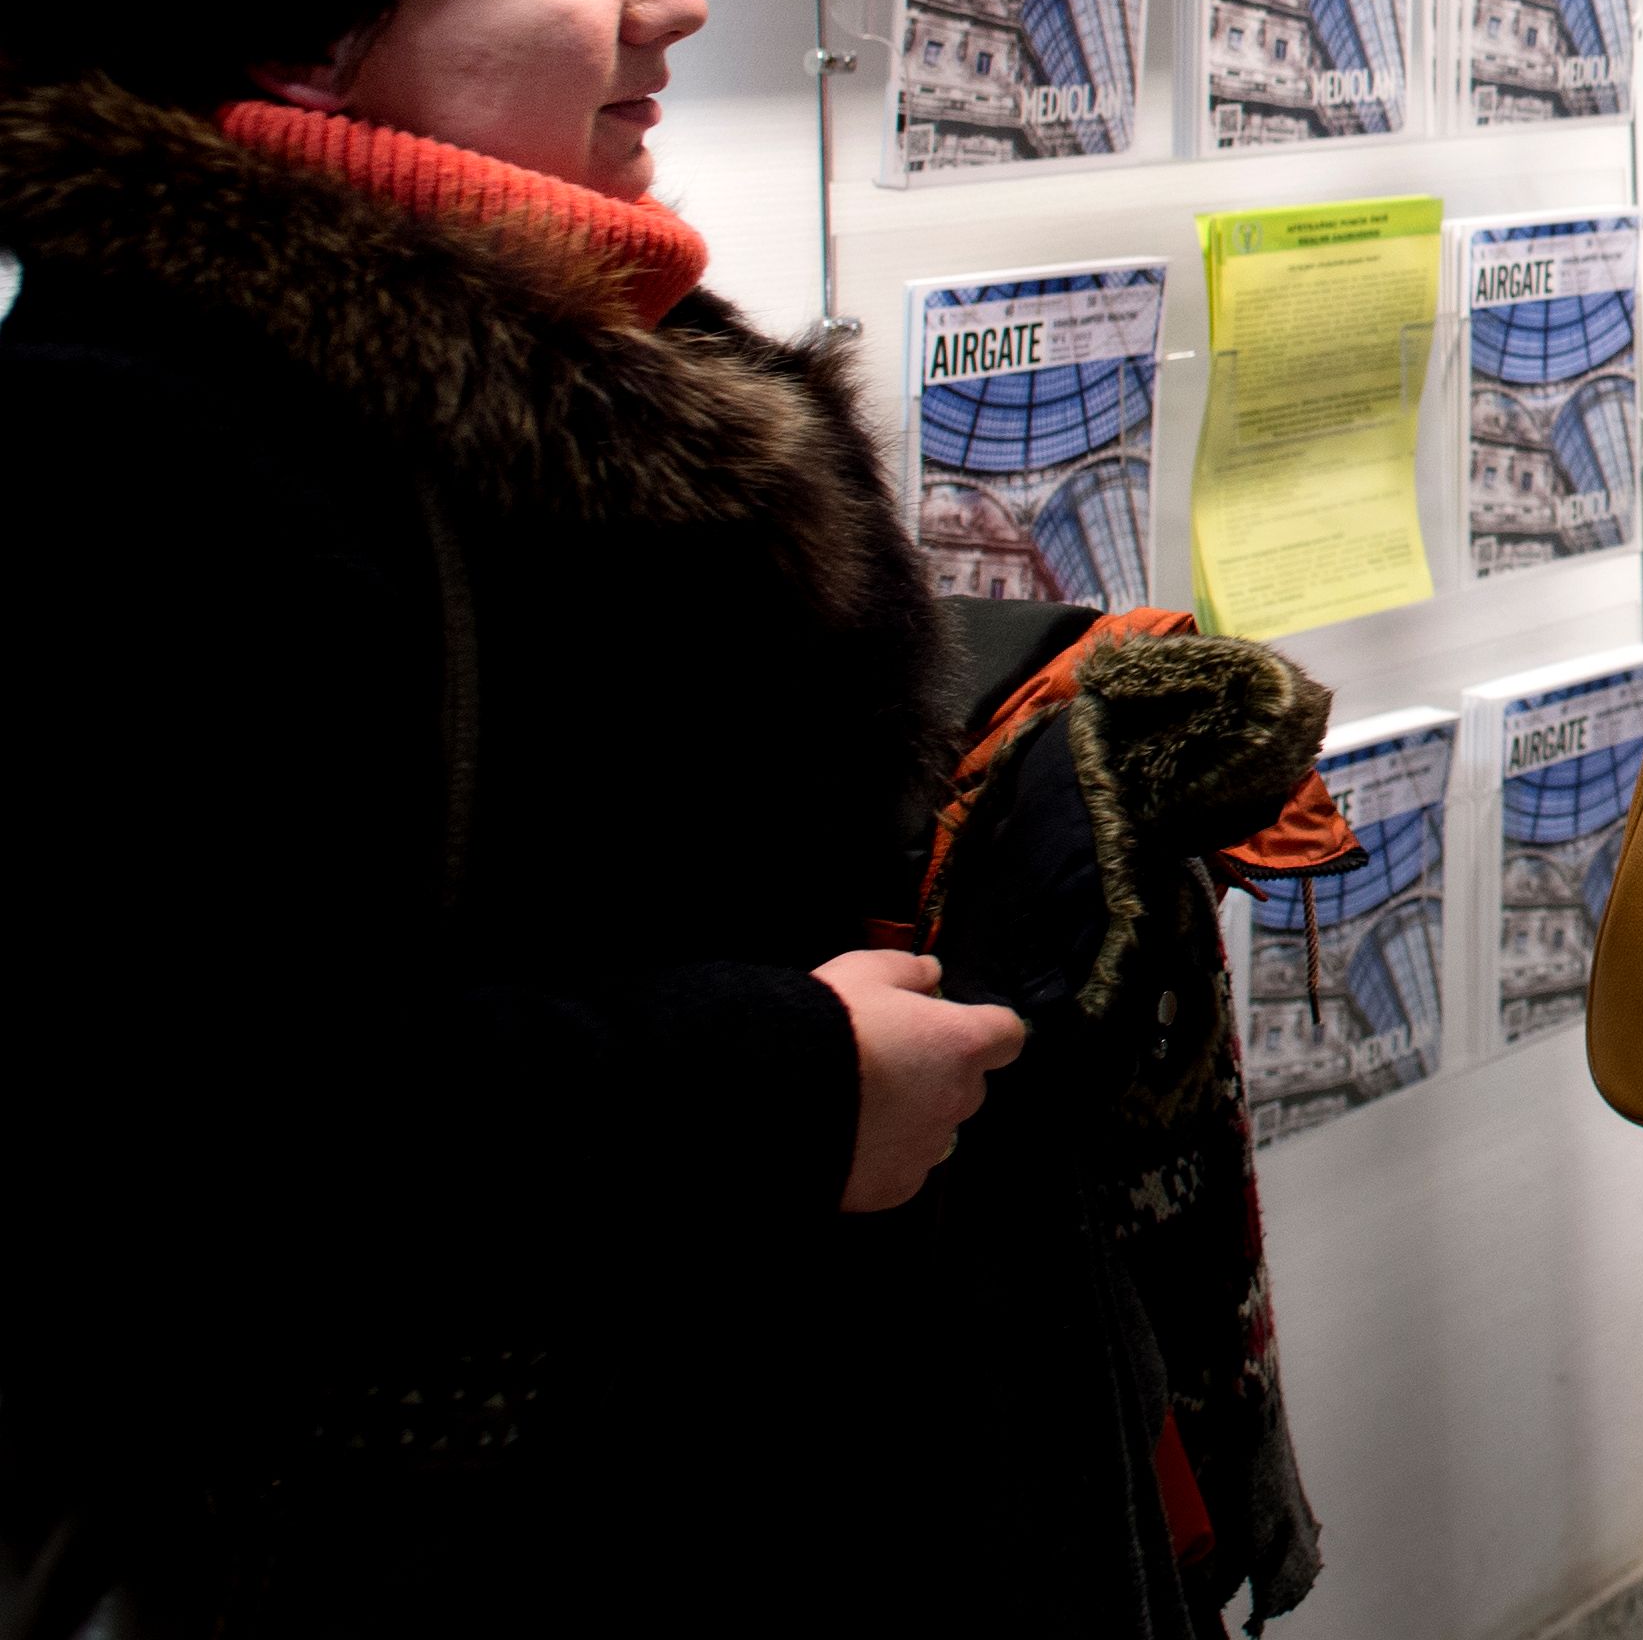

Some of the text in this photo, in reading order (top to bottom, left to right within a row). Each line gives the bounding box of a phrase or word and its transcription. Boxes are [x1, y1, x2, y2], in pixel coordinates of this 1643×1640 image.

[1020, 82, 1122, 126] MEDIOLAN
[1475, 259, 1554, 303] AIRGATE
[931, 322, 1044, 379] AIRGATE
[1508, 714, 1590, 772] AIRGATE
